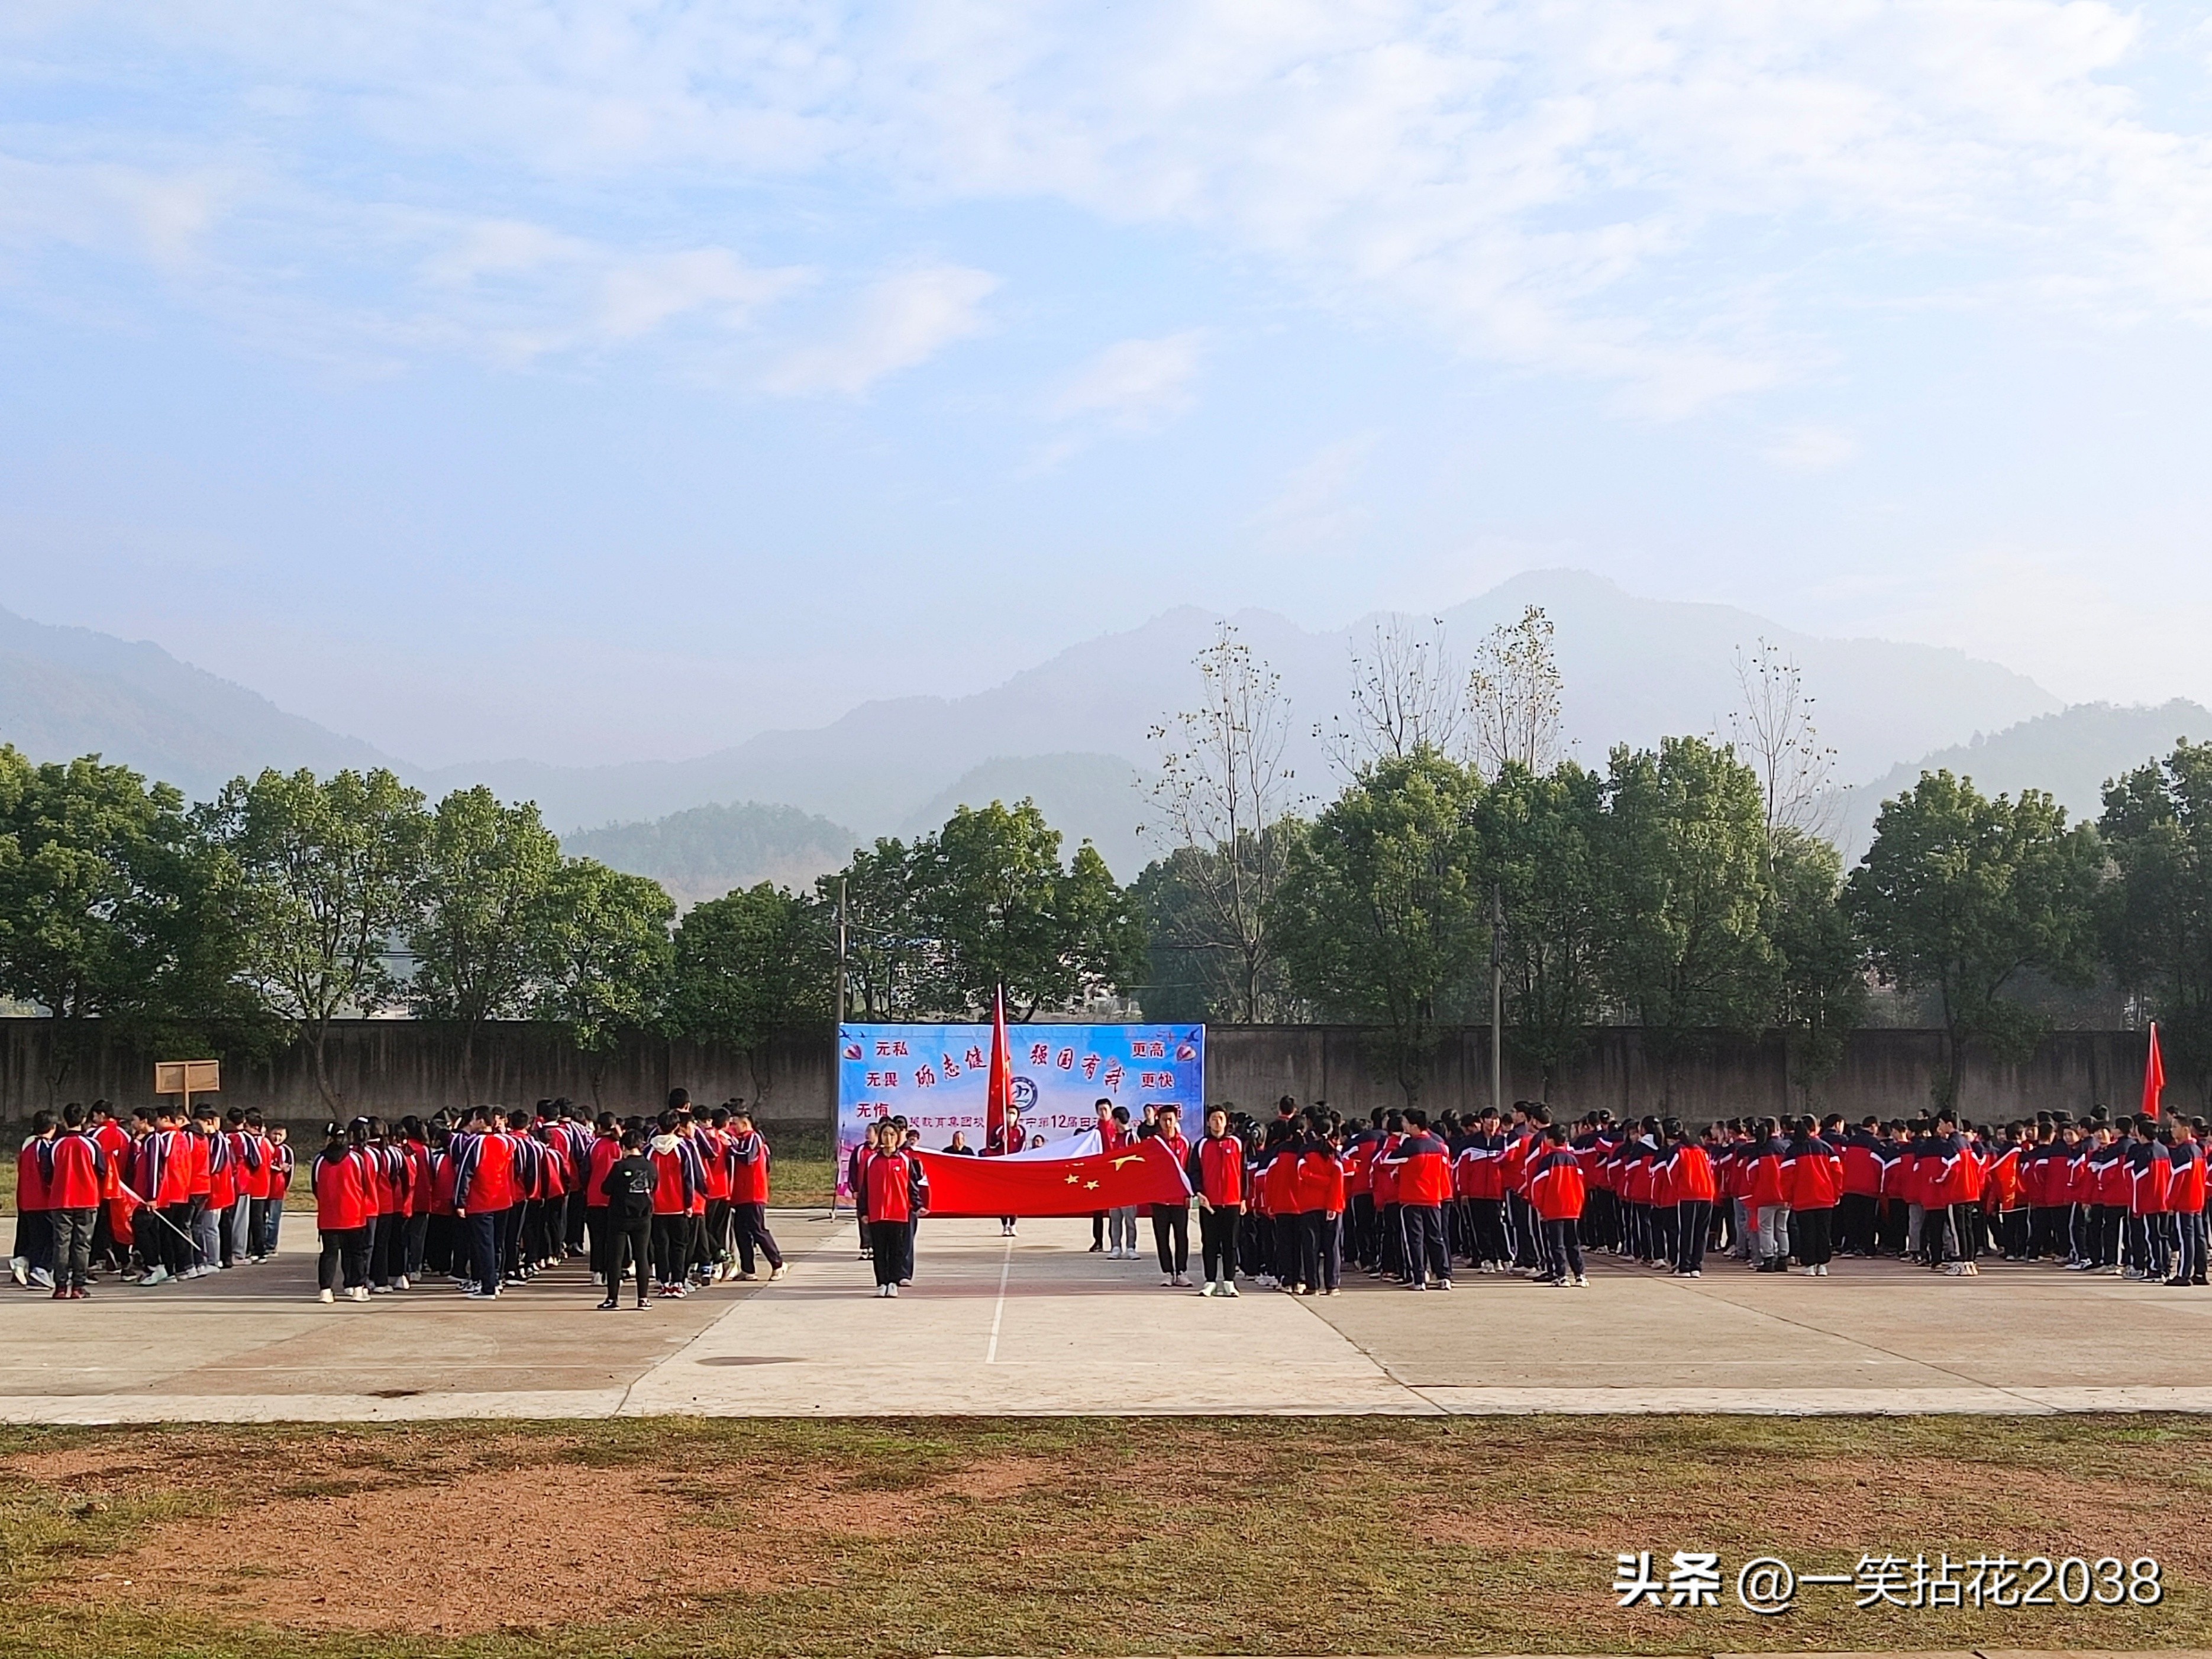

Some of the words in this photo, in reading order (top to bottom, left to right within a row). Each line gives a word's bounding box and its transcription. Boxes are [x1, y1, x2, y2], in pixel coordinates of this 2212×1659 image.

[876, 1041, 908, 1056] 无私
[1132, 1041, 1164, 1057] 更高
[866, 1072, 898, 1087] 无畏
[1141, 1072, 1174, 1087] 更快
[857, 1102, 889, 1118] 无悔
